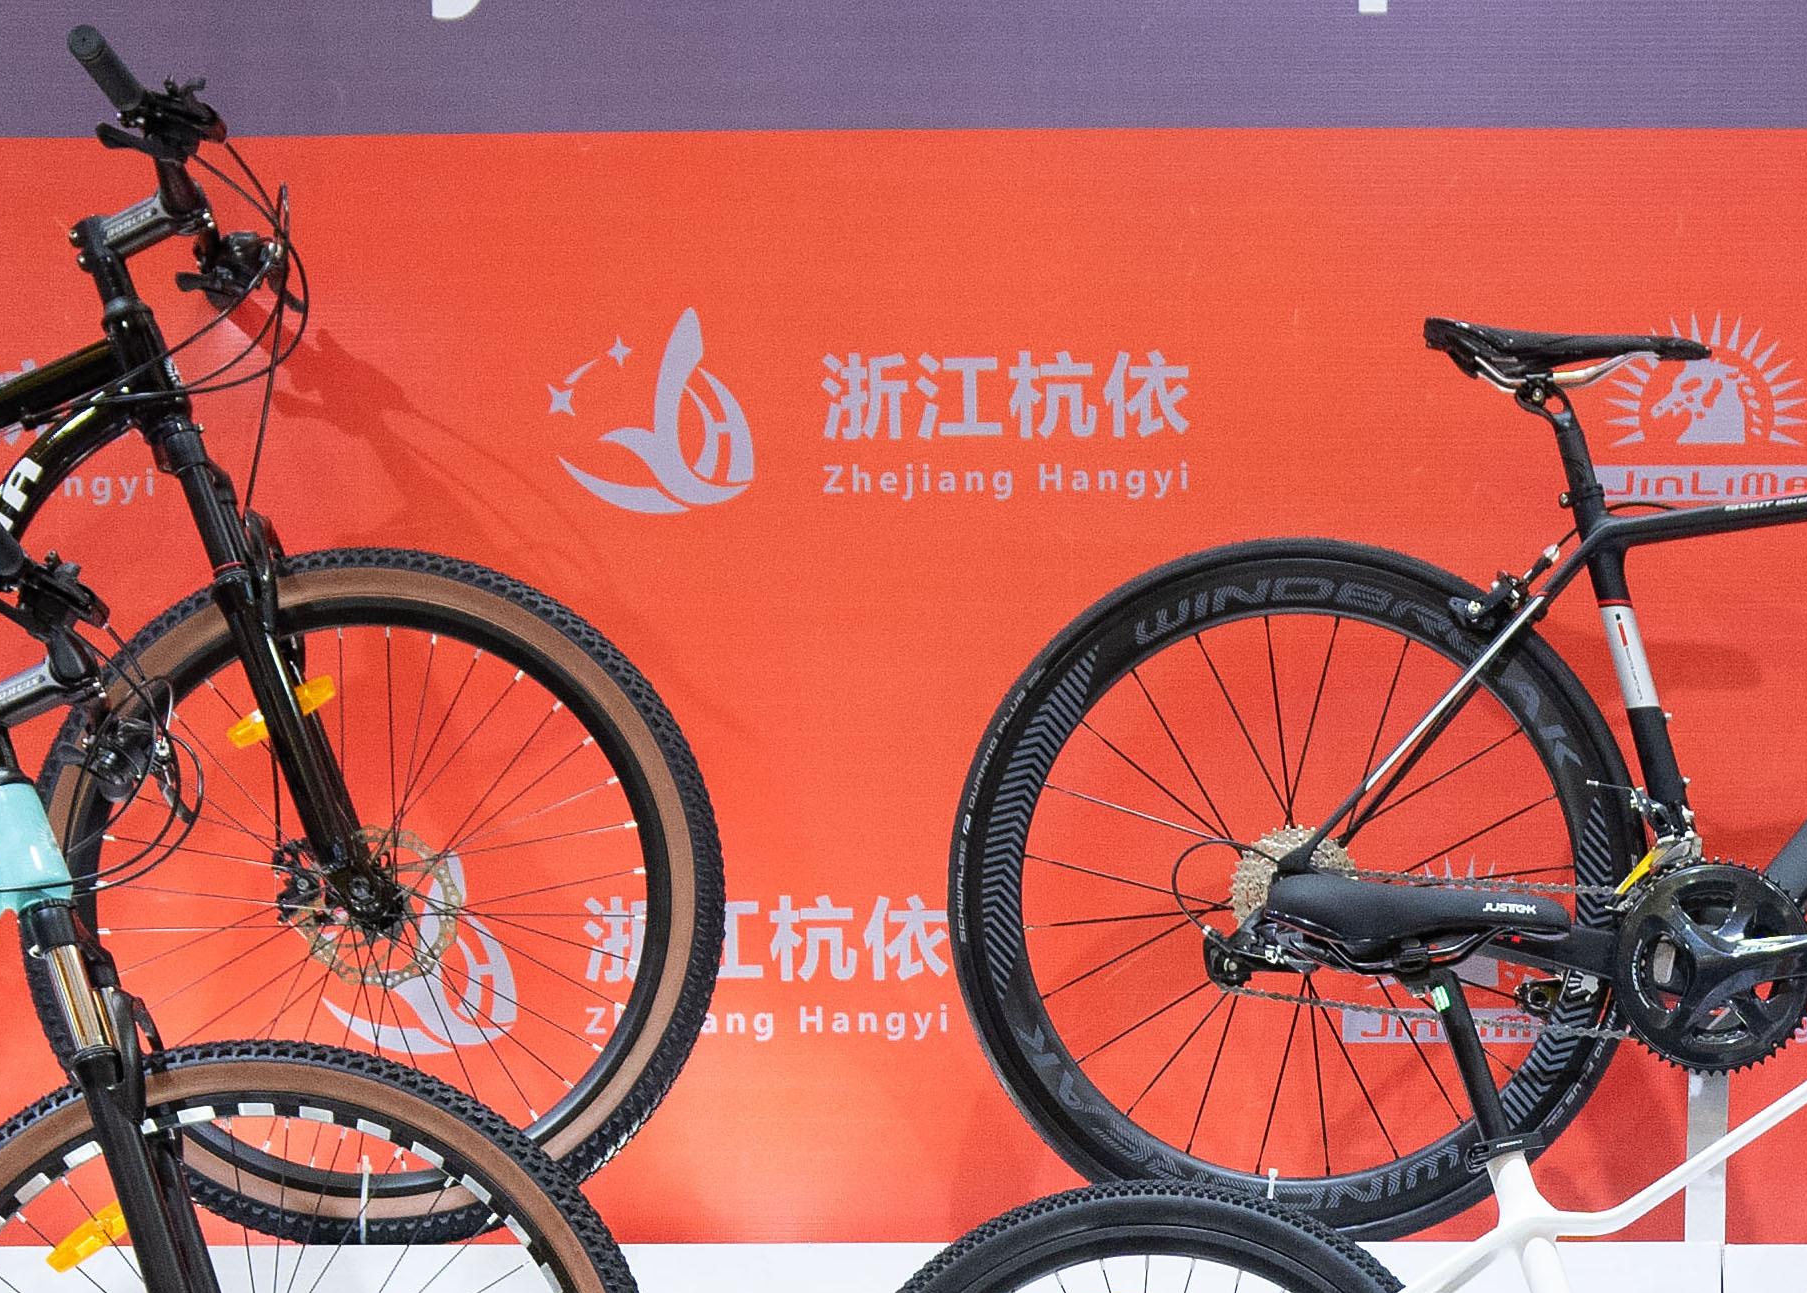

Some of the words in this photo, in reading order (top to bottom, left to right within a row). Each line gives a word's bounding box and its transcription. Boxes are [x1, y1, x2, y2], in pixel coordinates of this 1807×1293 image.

[821, 350, 1191, 441] 浙江杭依
[823, 464, 1015, 501] Zhejiang
[1039, 461, 1191, 501] Hangyi
[996, 689, 1028, 736] PLUS
[798, 1003, 949, 1043] Hangyi
